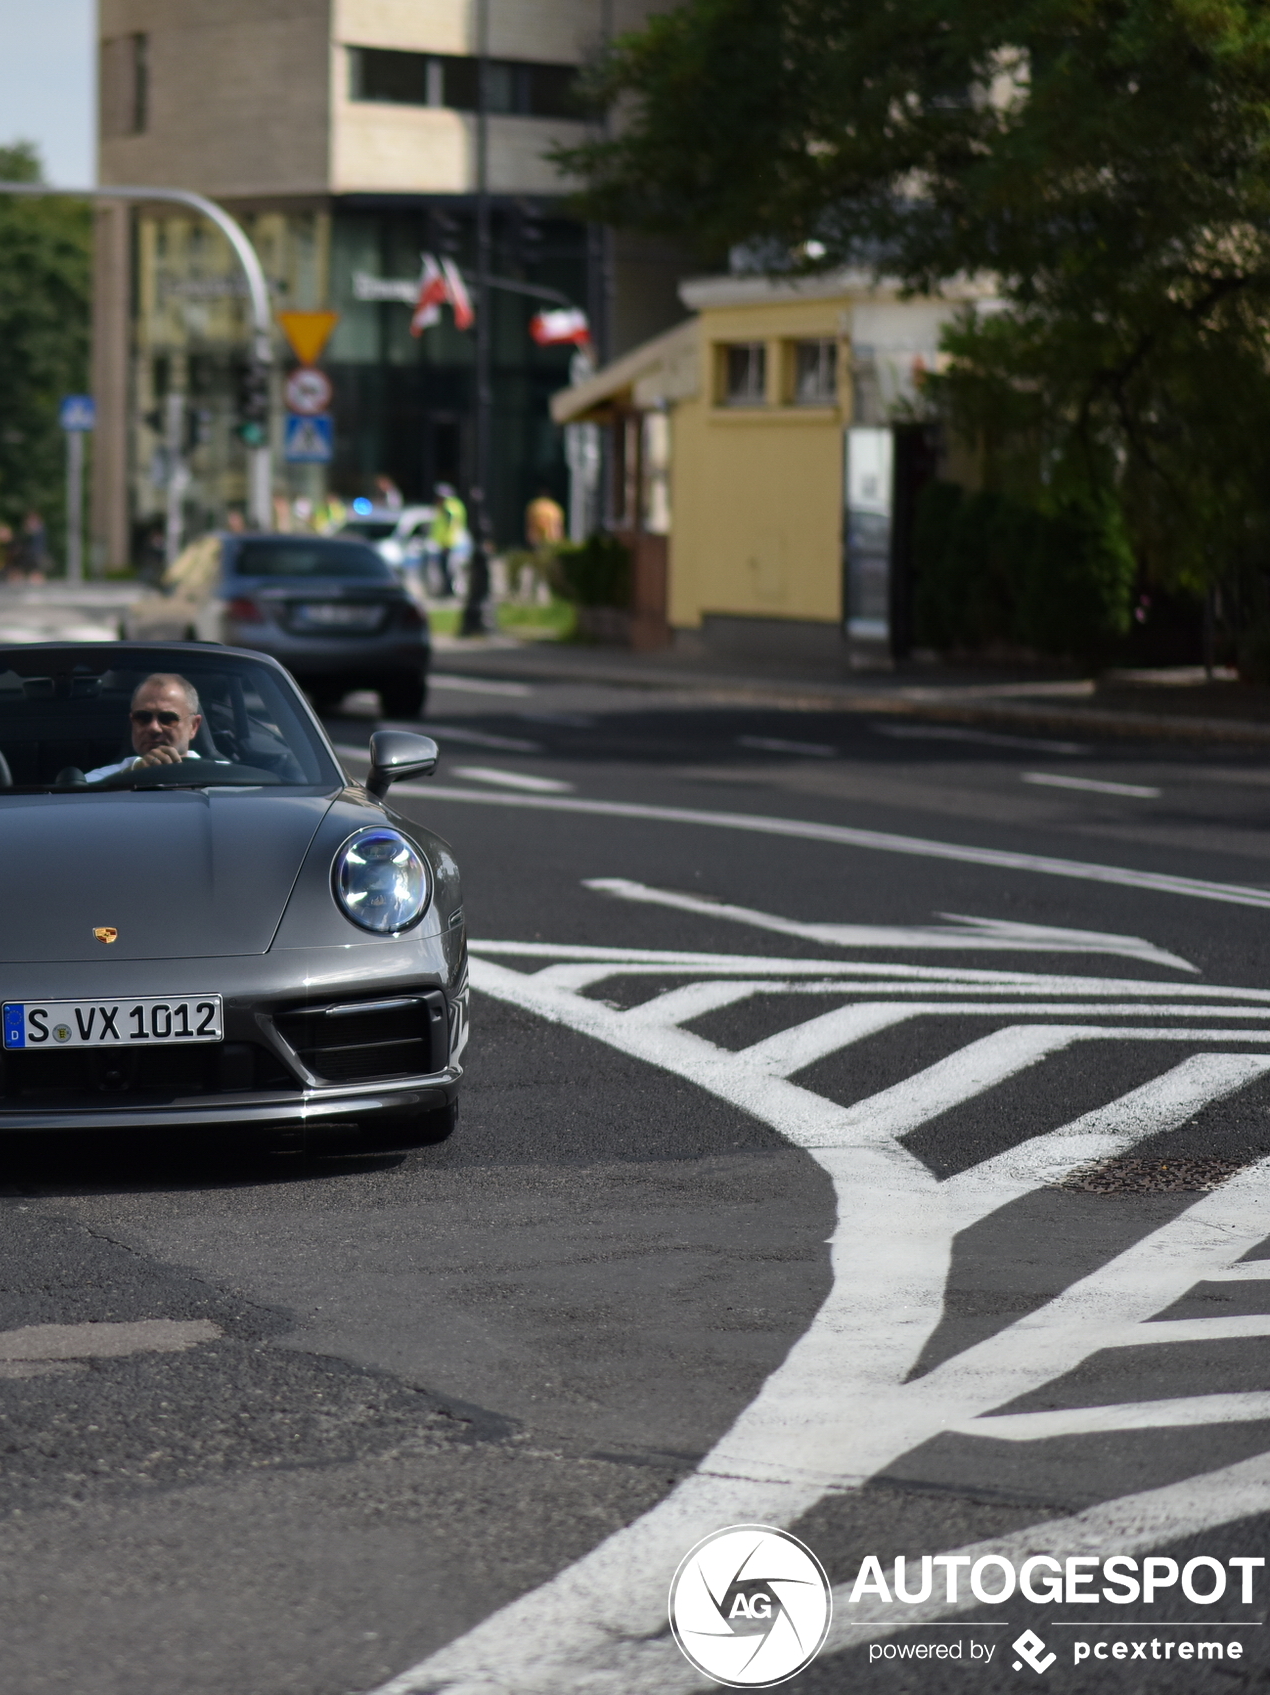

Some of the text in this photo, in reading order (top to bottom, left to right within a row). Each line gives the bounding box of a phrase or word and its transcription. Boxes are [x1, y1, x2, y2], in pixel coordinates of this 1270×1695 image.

[28, 1002, 216, 1042] S VX 1012
[11, 1030, 19, 1040] D
